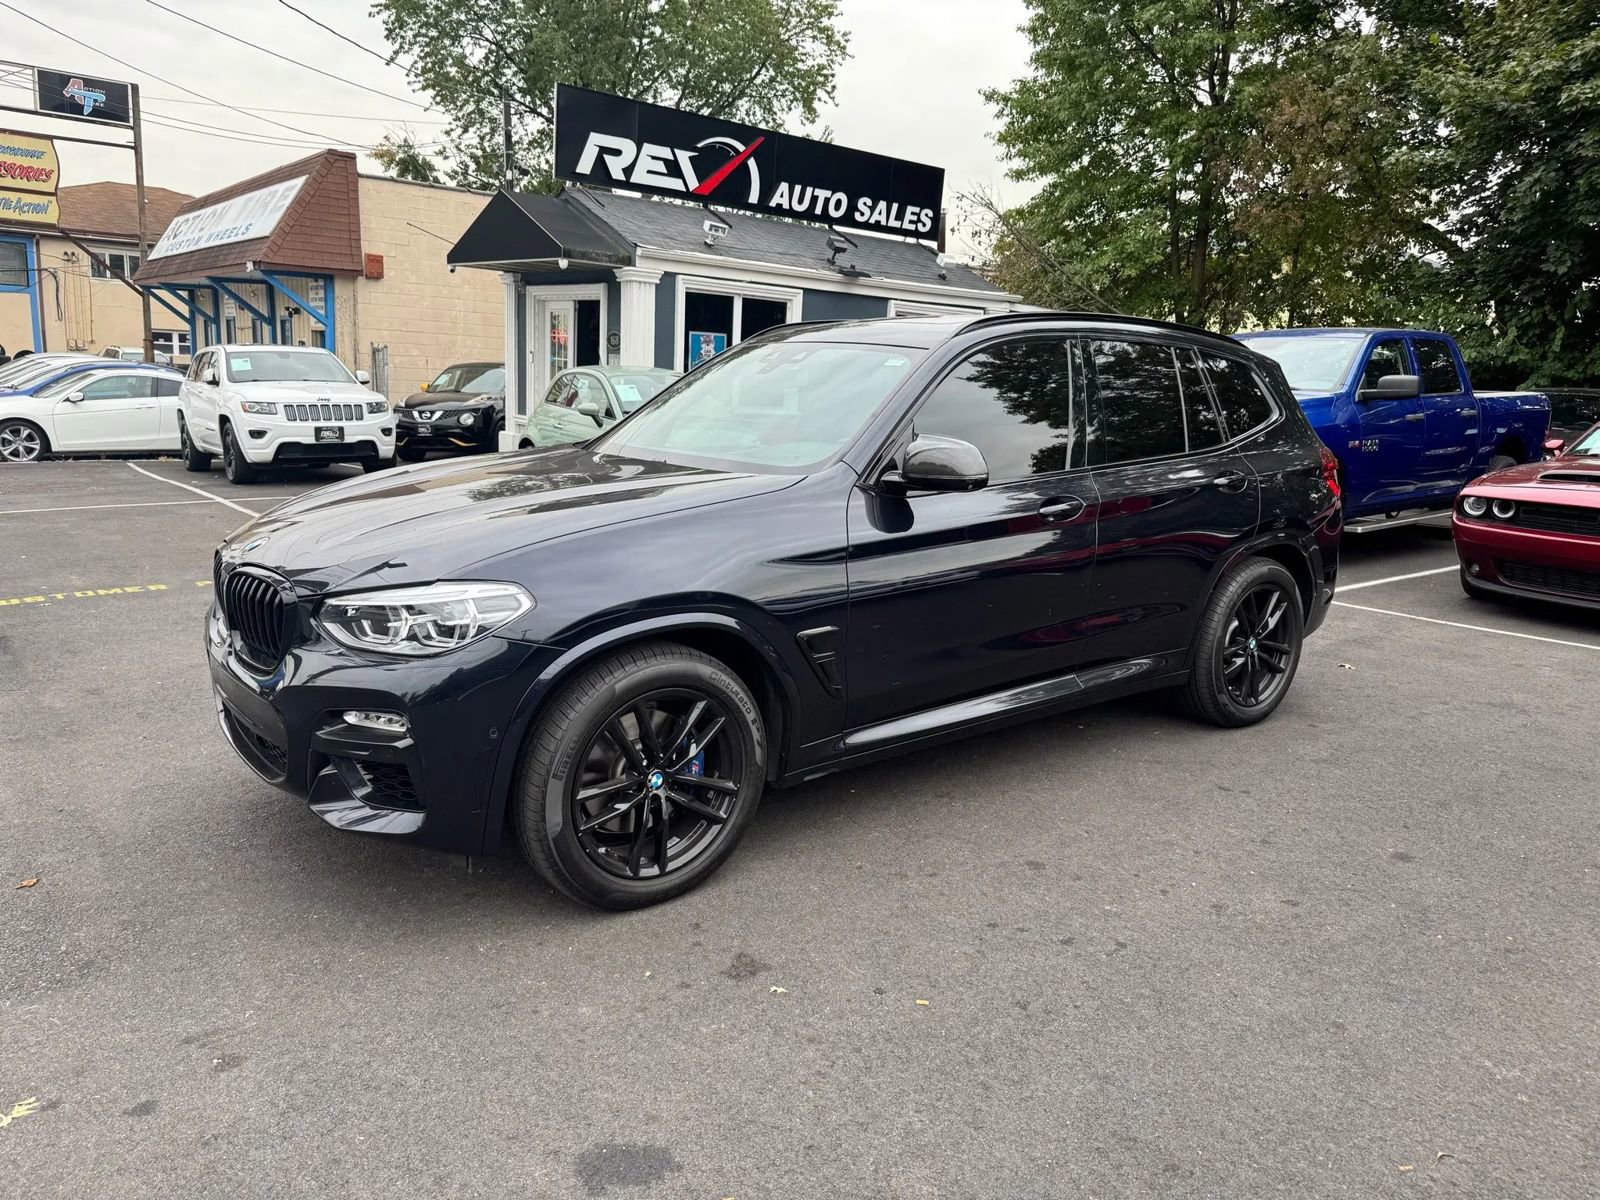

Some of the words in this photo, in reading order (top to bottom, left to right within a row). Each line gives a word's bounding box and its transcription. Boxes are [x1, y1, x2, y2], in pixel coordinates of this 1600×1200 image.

[161, 206, 232, 242] ACTION
[769, 181, 848, 219] AUTO
[854, 196, 934, 233] SALES
[204, 222, 252, 244] WHEELS
[709, 671, 752, 714] Cinturato
